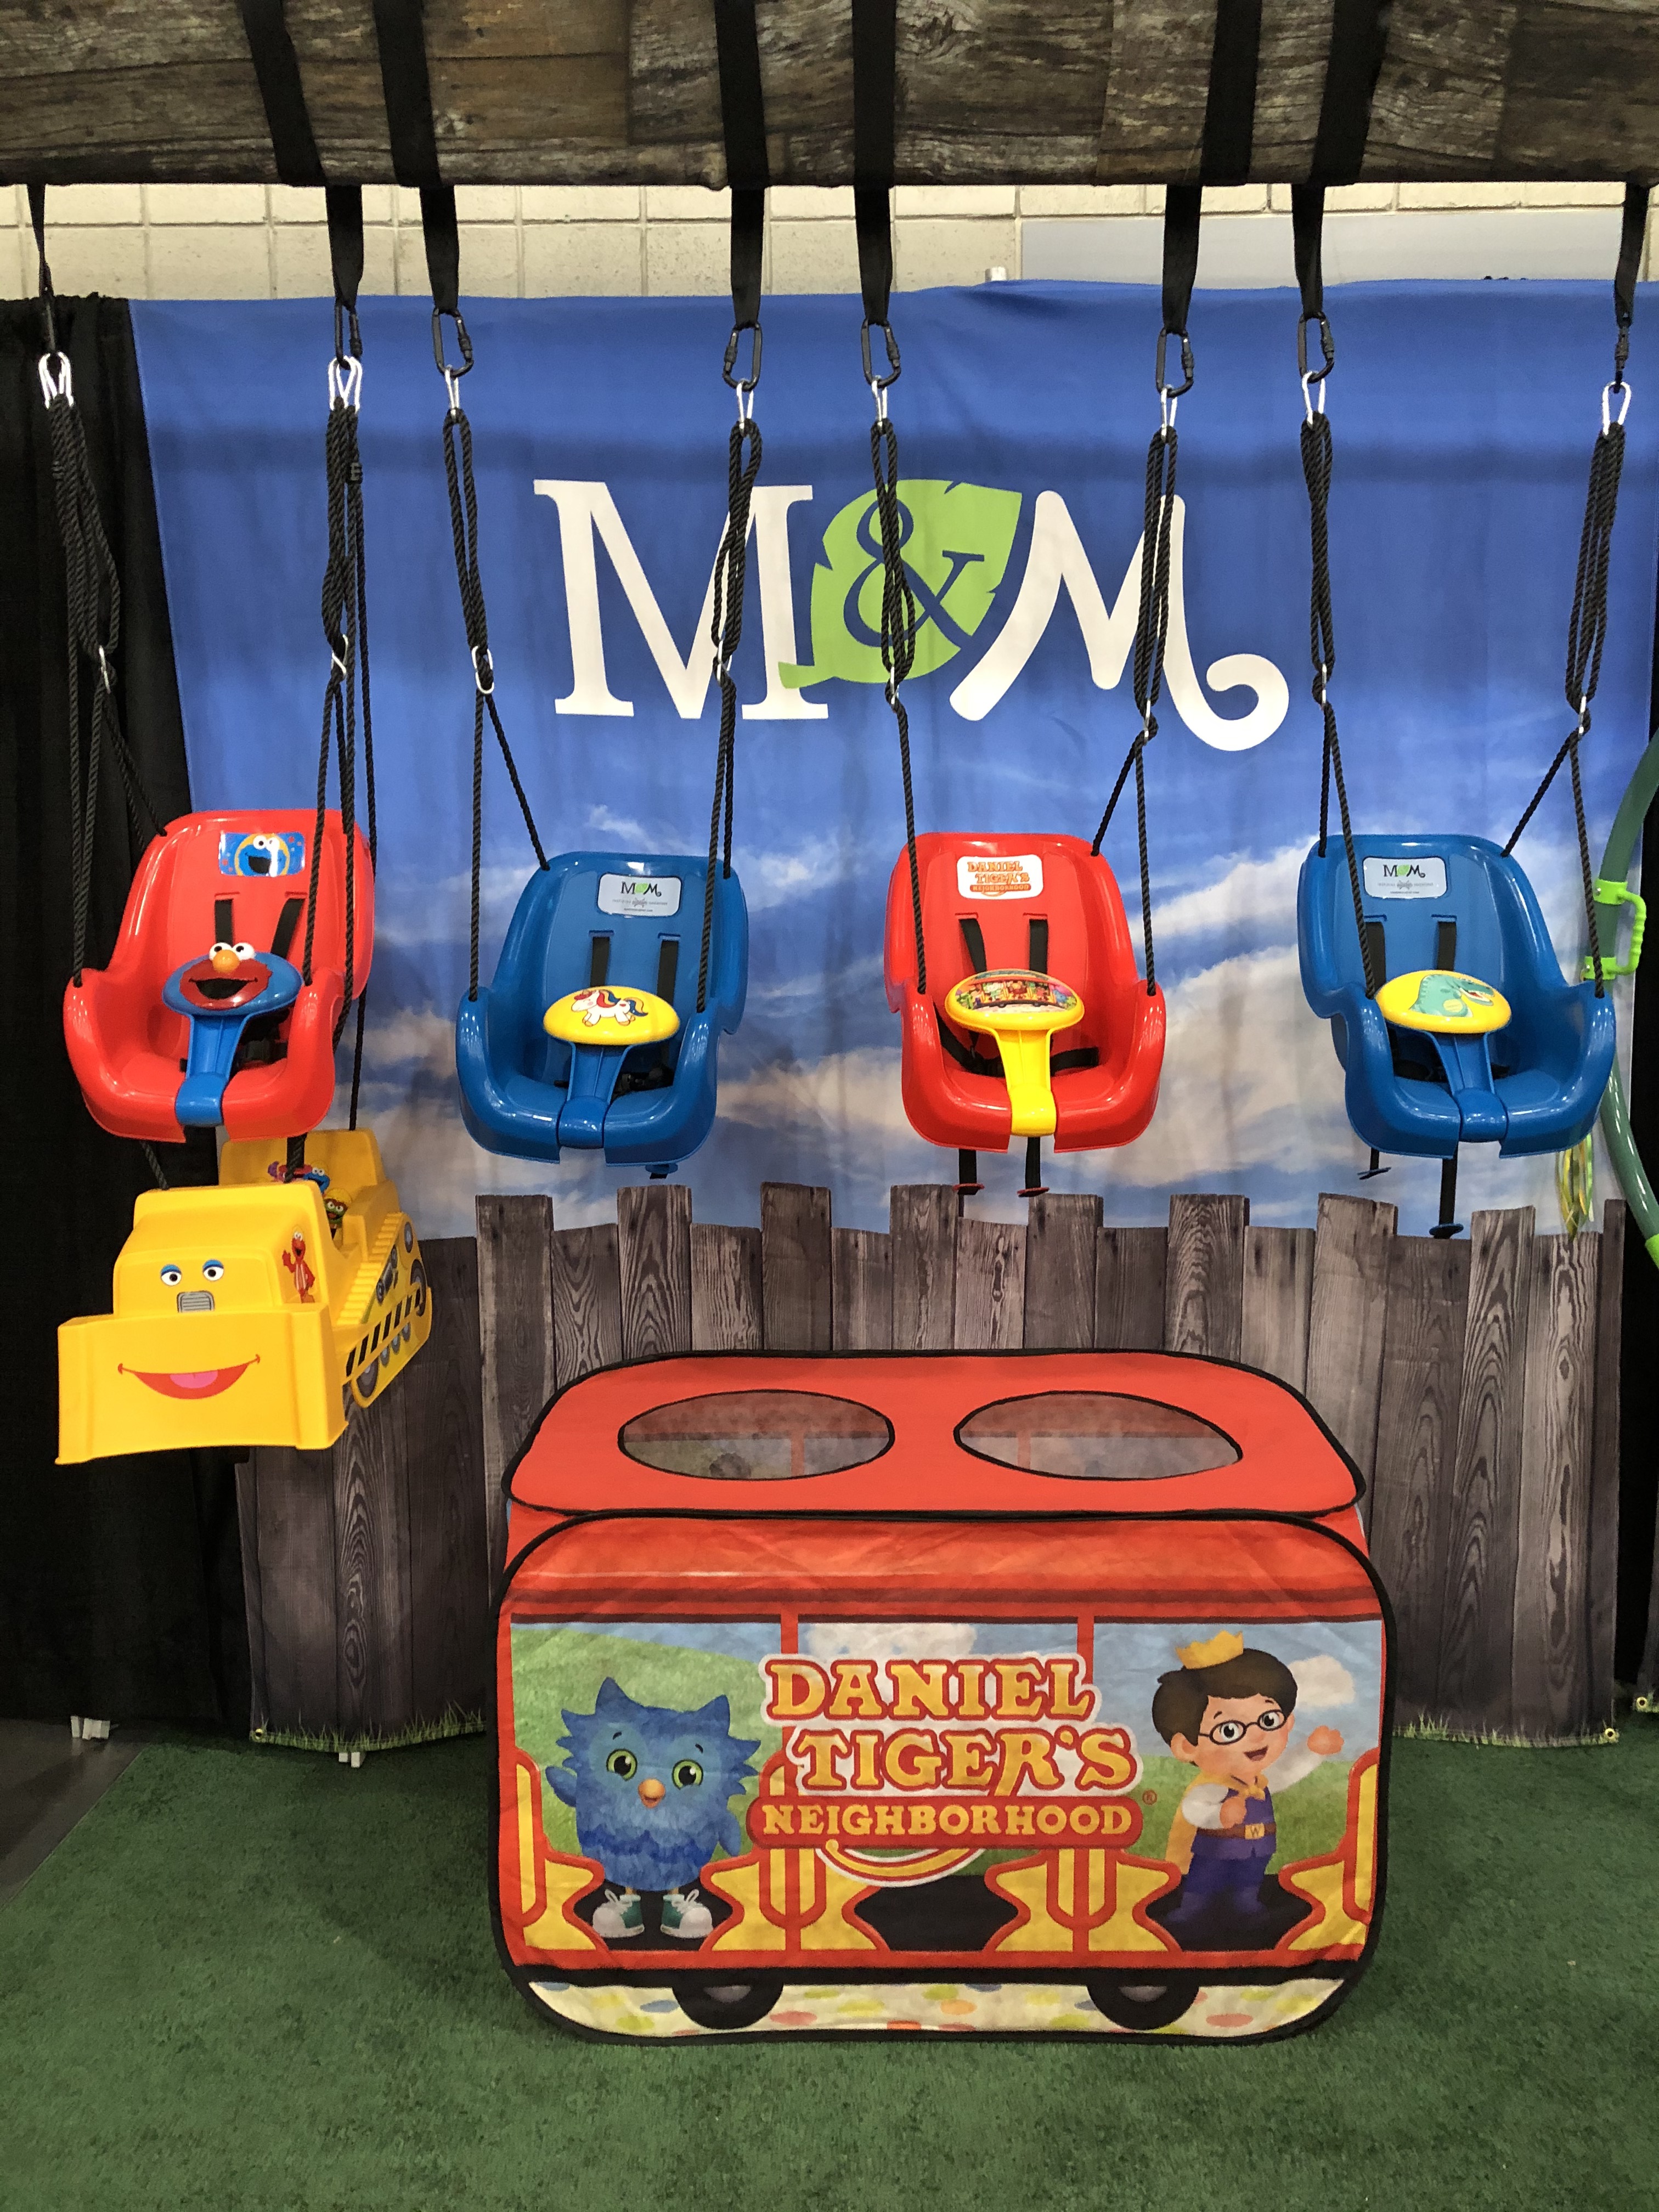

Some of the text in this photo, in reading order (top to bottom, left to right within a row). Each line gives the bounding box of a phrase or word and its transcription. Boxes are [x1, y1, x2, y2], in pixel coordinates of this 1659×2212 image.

[534, 479, 1289, 752] M&M
[967, 861, 1023, 872] DANIEL
[975, 872, 1030, 885] TIGER'S
[766, 1659, 1096, 1720] DANIEL
[795, 1727, 1137, 1796] TIGER'S
[762, 1803, 1133, 1836] NEIGHBORHOOD
